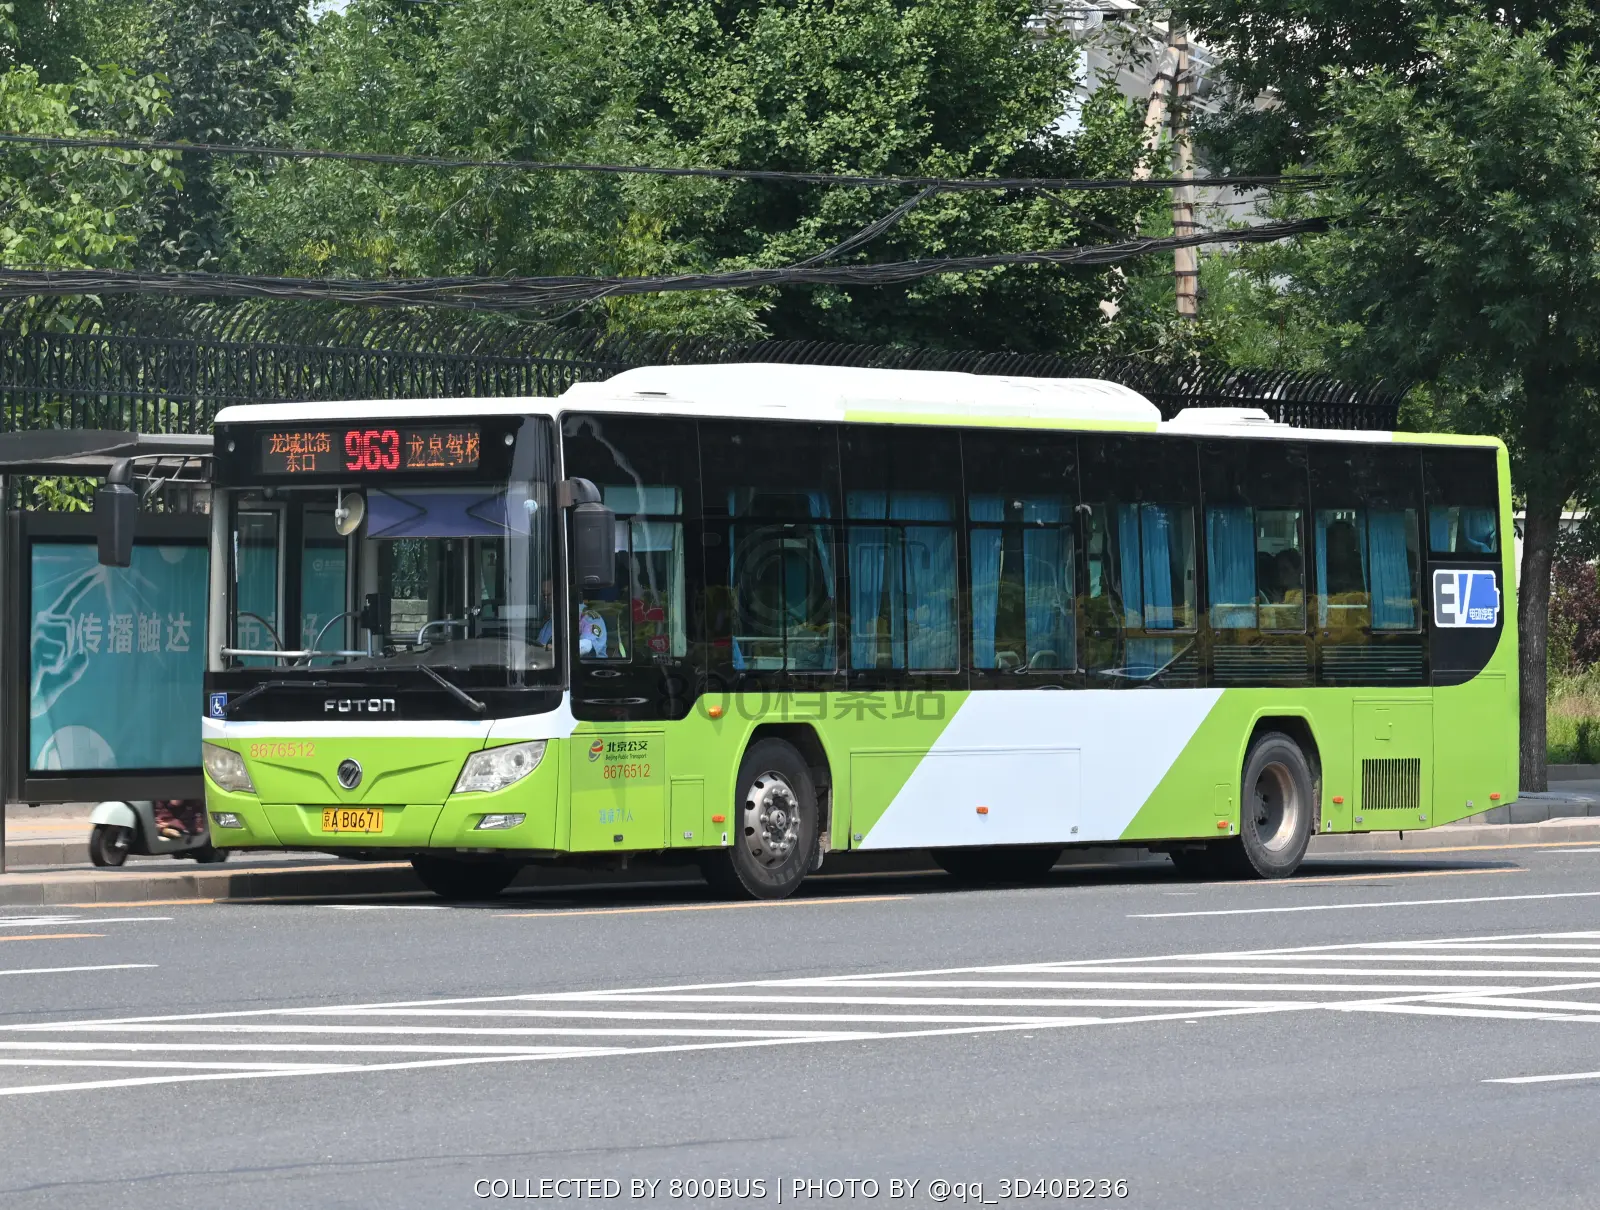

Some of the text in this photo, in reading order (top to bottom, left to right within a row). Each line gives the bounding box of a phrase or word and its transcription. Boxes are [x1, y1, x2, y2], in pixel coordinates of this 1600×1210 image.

[269, 432, 331, 454] 龙域北街
[345, 430, 400, 471] 963
[287, 453, 315, 472] 东口
[1435, 572, 1473, 625] EV
[76, 612, 191, 655] 传播触达
[324, 698, 395, 712] FOTON
[250, 742, 315, 757] 8676512
[606, 741, 648, 752] 北京公交
[603, 763, 650, 779] 8676512
